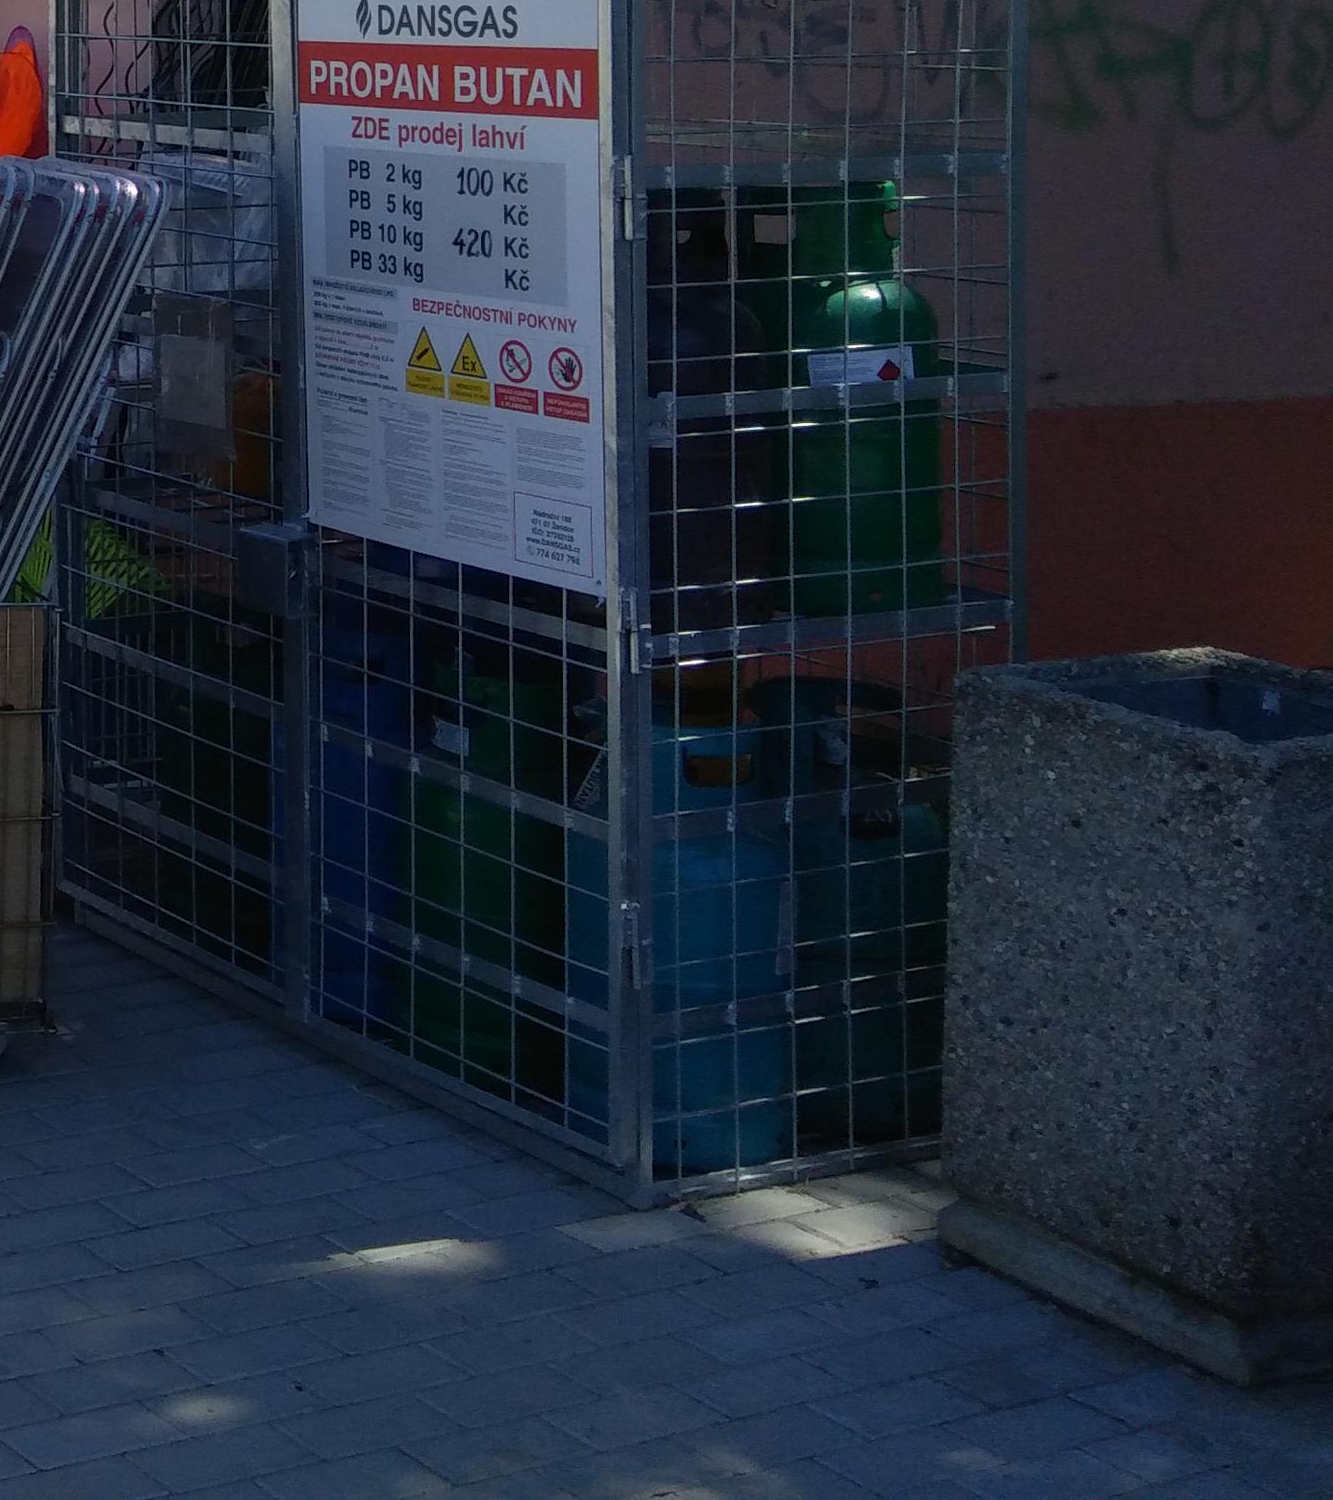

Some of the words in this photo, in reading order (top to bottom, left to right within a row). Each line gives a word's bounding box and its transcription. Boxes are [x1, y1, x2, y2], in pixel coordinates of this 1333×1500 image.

[378, 4, 518, 39] DANSGAS
[310, 59, 439, 102] PROPAN
[453, 65, 582, 109] BUTAN
[351, 116, 390, 142] ZDE
[398, 121, 463, 152] prodej
[472, 124, 526, 150] lahví
[348, 159, 370, 180] PB
[386, 163, 396, 183] 2
[402, 165, 422, 189] kg
[456, 166, 493, 196] 100
[503, 171, 529, 194] Kč
[349, 189, 371, 211] PB
[387, 194, 396, 213] 5
[402, 196, 423, 221] kg
[504, 203, 529, 226] Kč
[349, 220, 371, 241] PB
[378, 223, 396, 245] 10
[403, 226, 423, 252] kg
[452, 228, 493, 258] 420
[504, 235, 530, 259] Kč
[350, 250, 372, 271] PB
[378, 253, 397, 274] 33
[403, 256, 424, 283] kg
[505, 268, 530, 291] Kč
[412, 298, 513, 325] BEZPEČNOSTNÍ
[518, 312, 577, 333] POKYNY
[462, 356, 477, 373] Ex
[536, 548, 550, 558] 774
